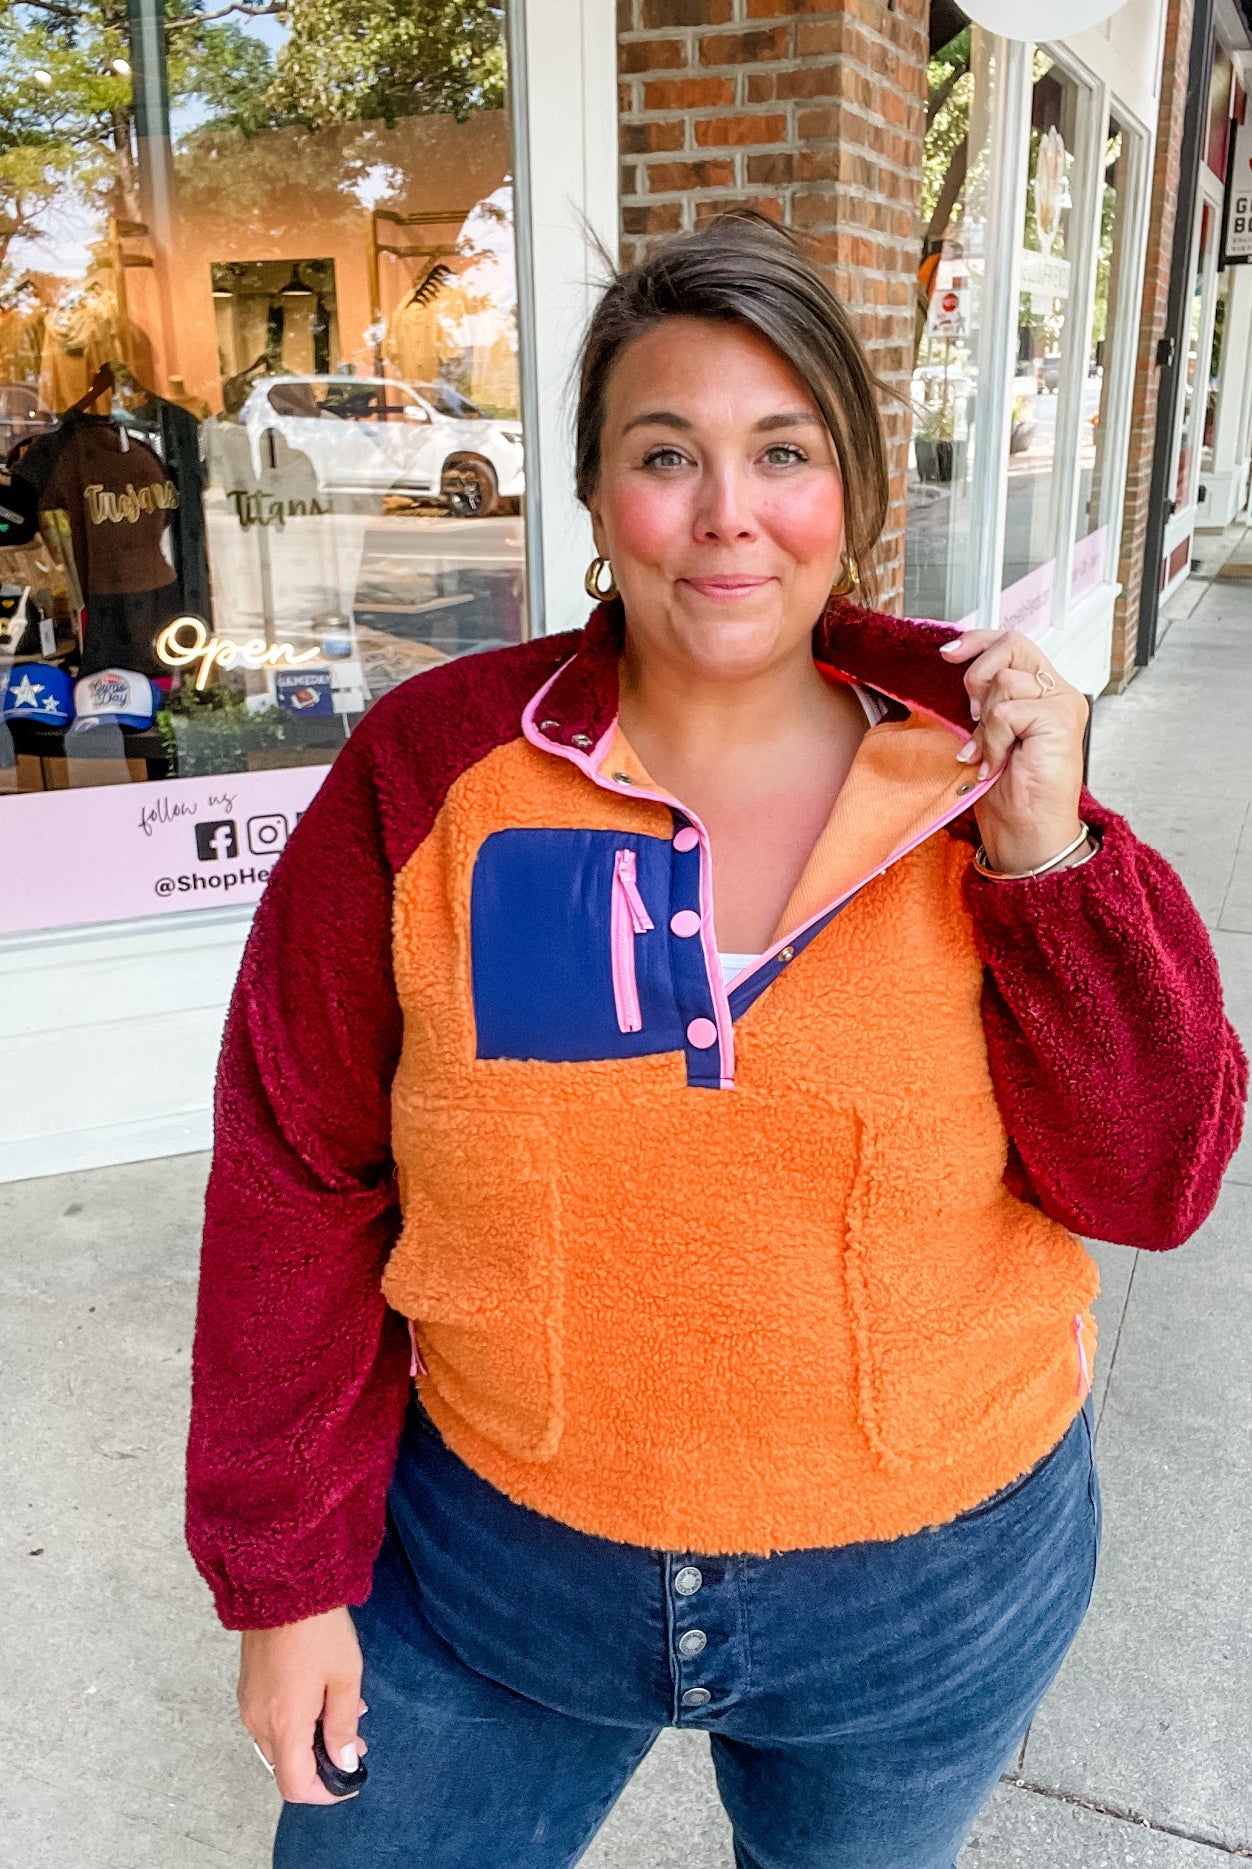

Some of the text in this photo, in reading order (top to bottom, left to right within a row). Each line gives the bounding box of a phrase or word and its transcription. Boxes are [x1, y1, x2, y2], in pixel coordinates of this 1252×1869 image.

[1236, 197, 1252, 214] G
[83, 480, 181, 526] Trojans
[226, 489, 329, 531] Titans
[156, 617, 321, 691] Open
[97, 691, 128, 708] Day
[138, 793, 238, 837] follow us
[155, 864, 274, 897] @ShopHe
